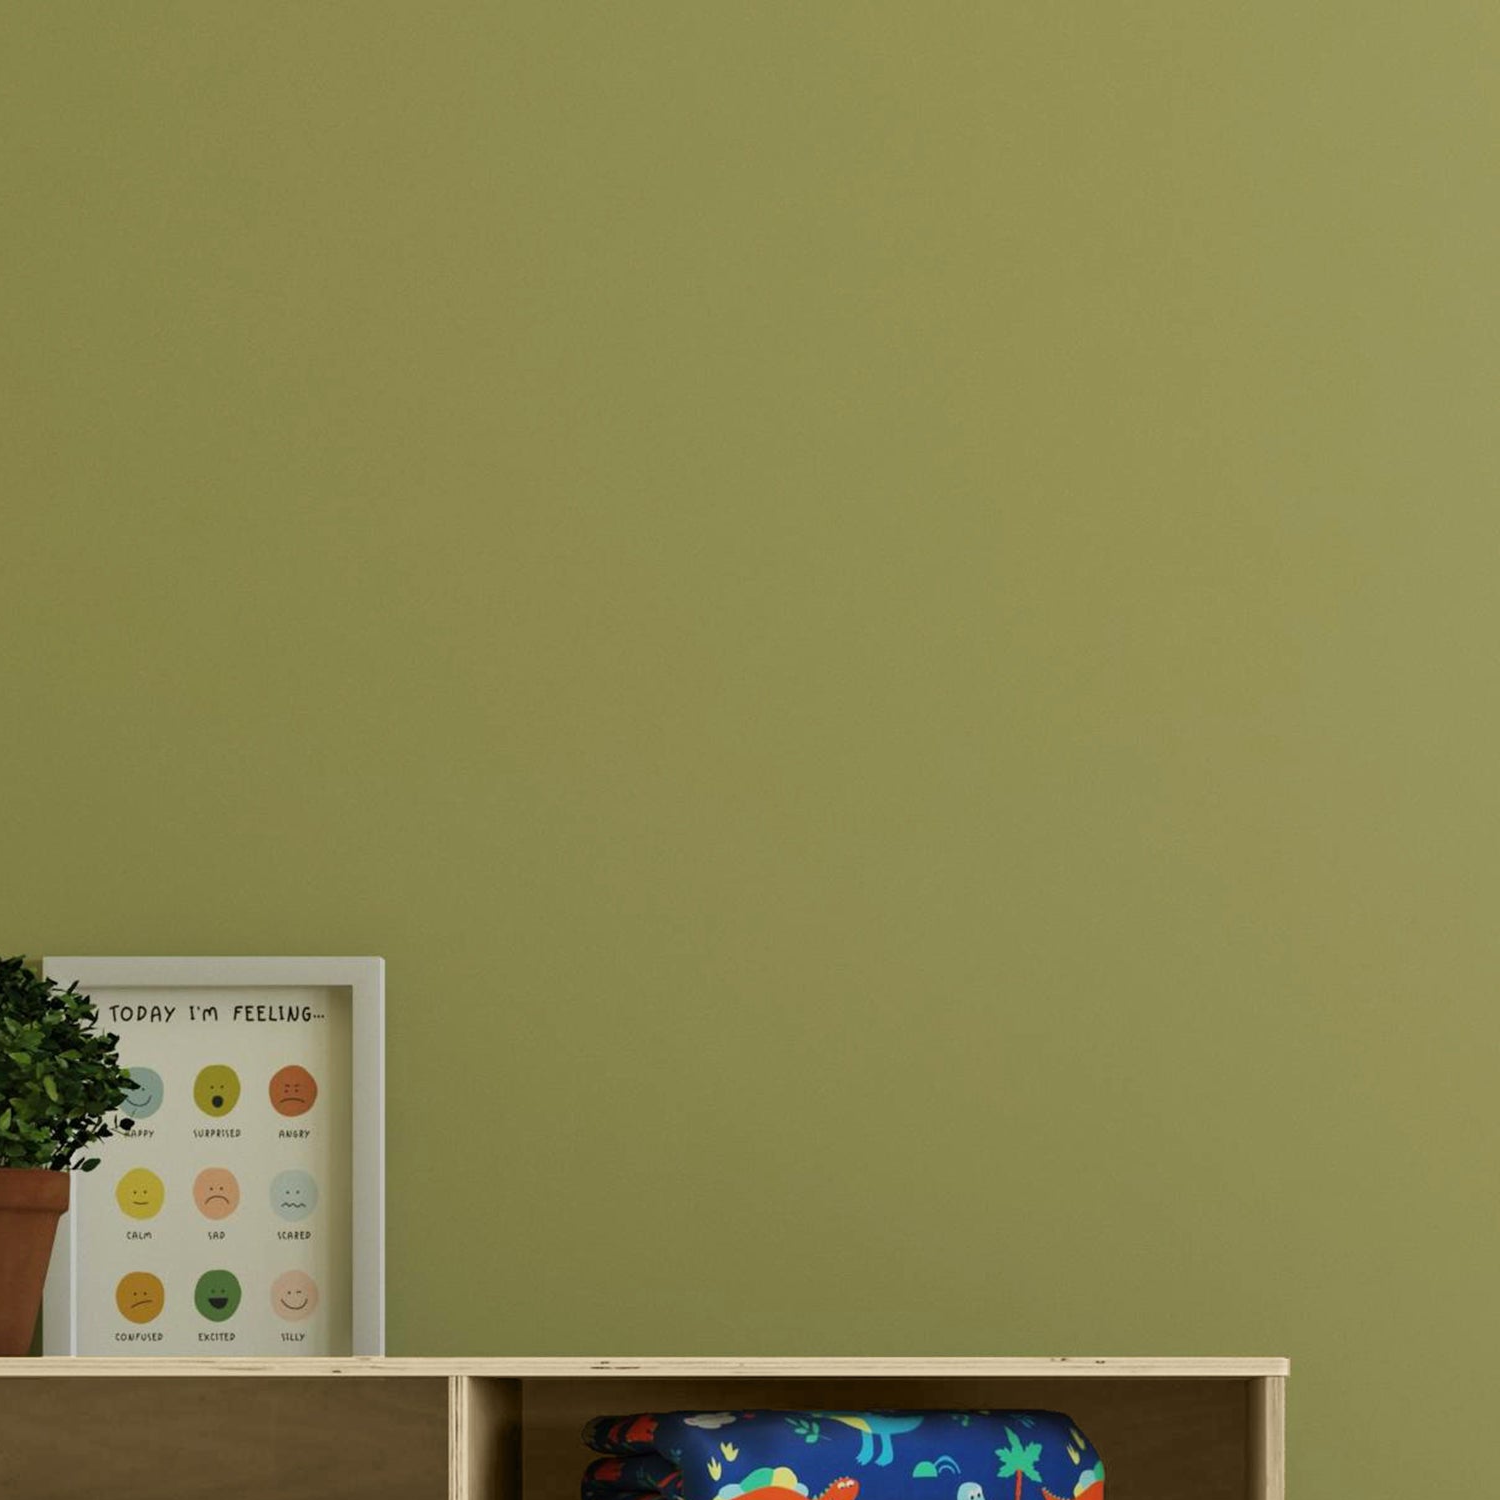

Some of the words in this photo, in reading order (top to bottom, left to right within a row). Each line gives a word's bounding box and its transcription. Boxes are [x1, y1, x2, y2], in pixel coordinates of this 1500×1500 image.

[108, 1004, 177, 1023] TODAY
[188, 1005, 219, 1022] I'M
[127, 1129, 155, 1138] APPY
[192, 1128, 242, 1138] SURPRISED
[278, 1129, 311, 1139] ANGRY
[126, 1231, 153, 1241] CALM
[208, 1231, 226, 1241] SAD
[277, 1231, 312, 1241] SCARED
[115, 1332, 164, 1342] CONFUSED
[198, 1332, 236, 1342] EXCITED
[280, 1332, 306, 1342] SILLY
